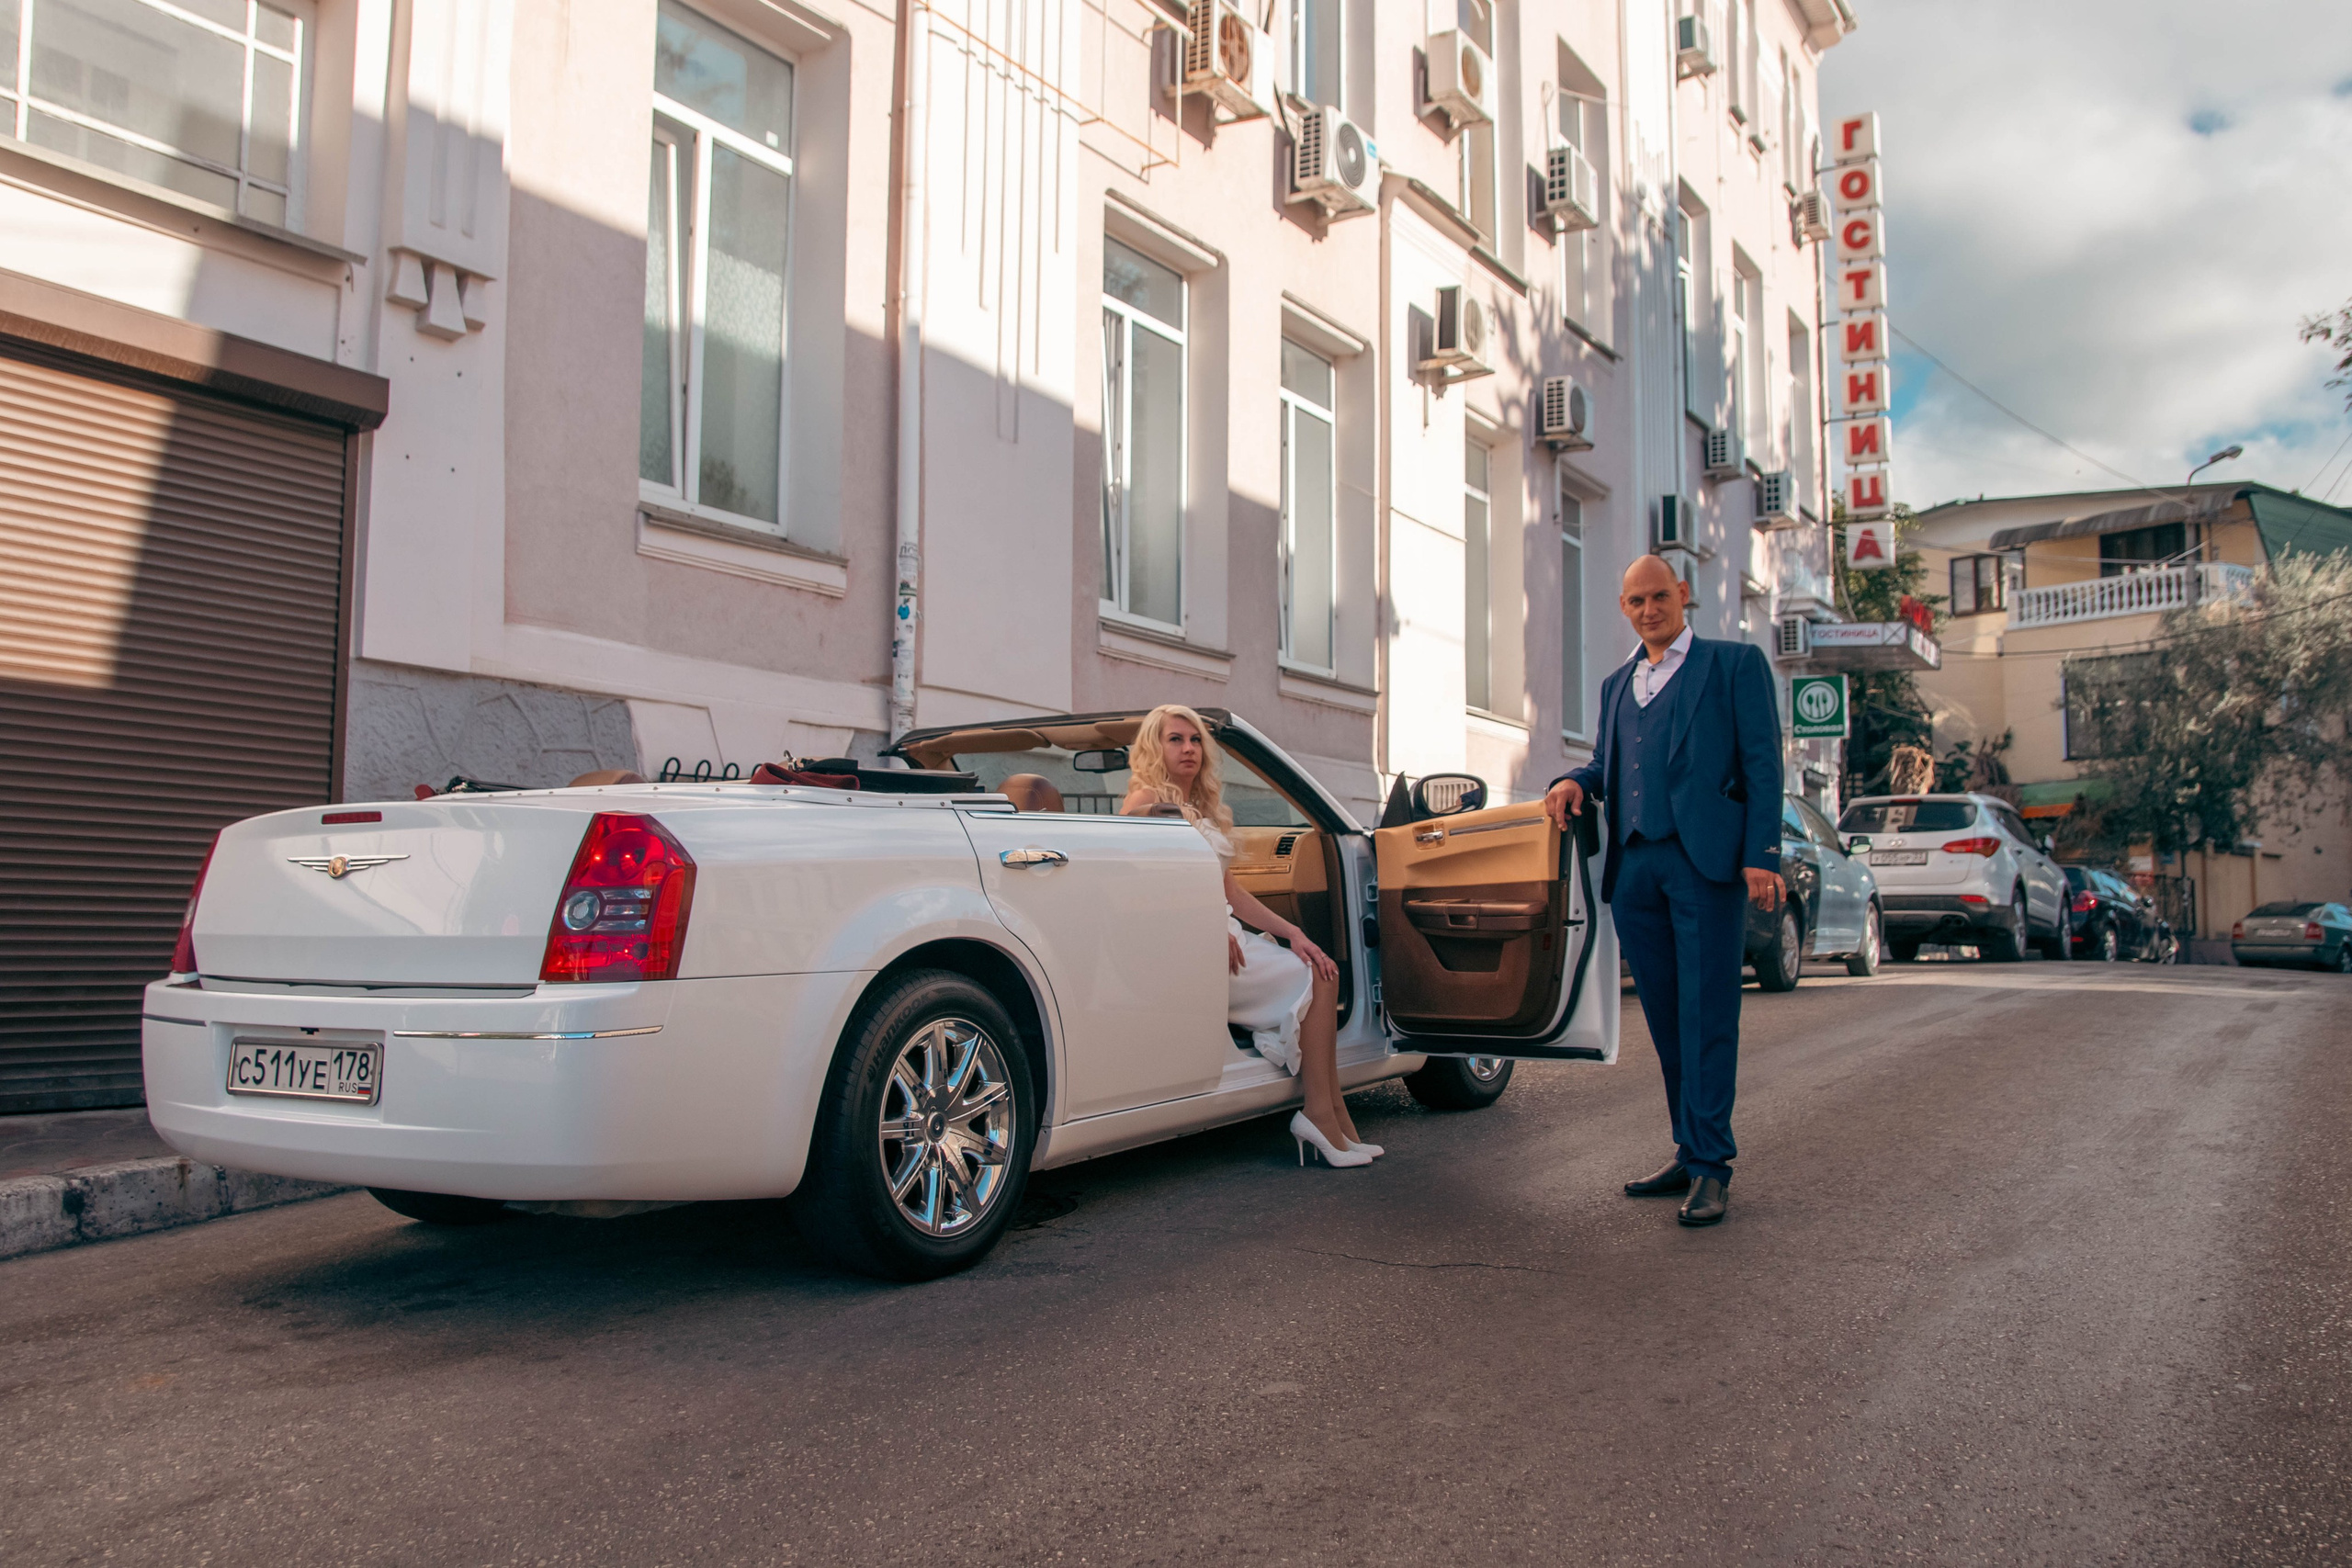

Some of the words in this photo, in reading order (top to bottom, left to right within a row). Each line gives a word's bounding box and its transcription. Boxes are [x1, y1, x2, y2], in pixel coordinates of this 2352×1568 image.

[1840, 119, 1884, 561] ГОСТИНИЦА
[1811, 628, 1879, 639] ГОСТИНИЦА
[334, 1051, 370, 1081] 178
[338, 1081, 357, 1093] RUS
